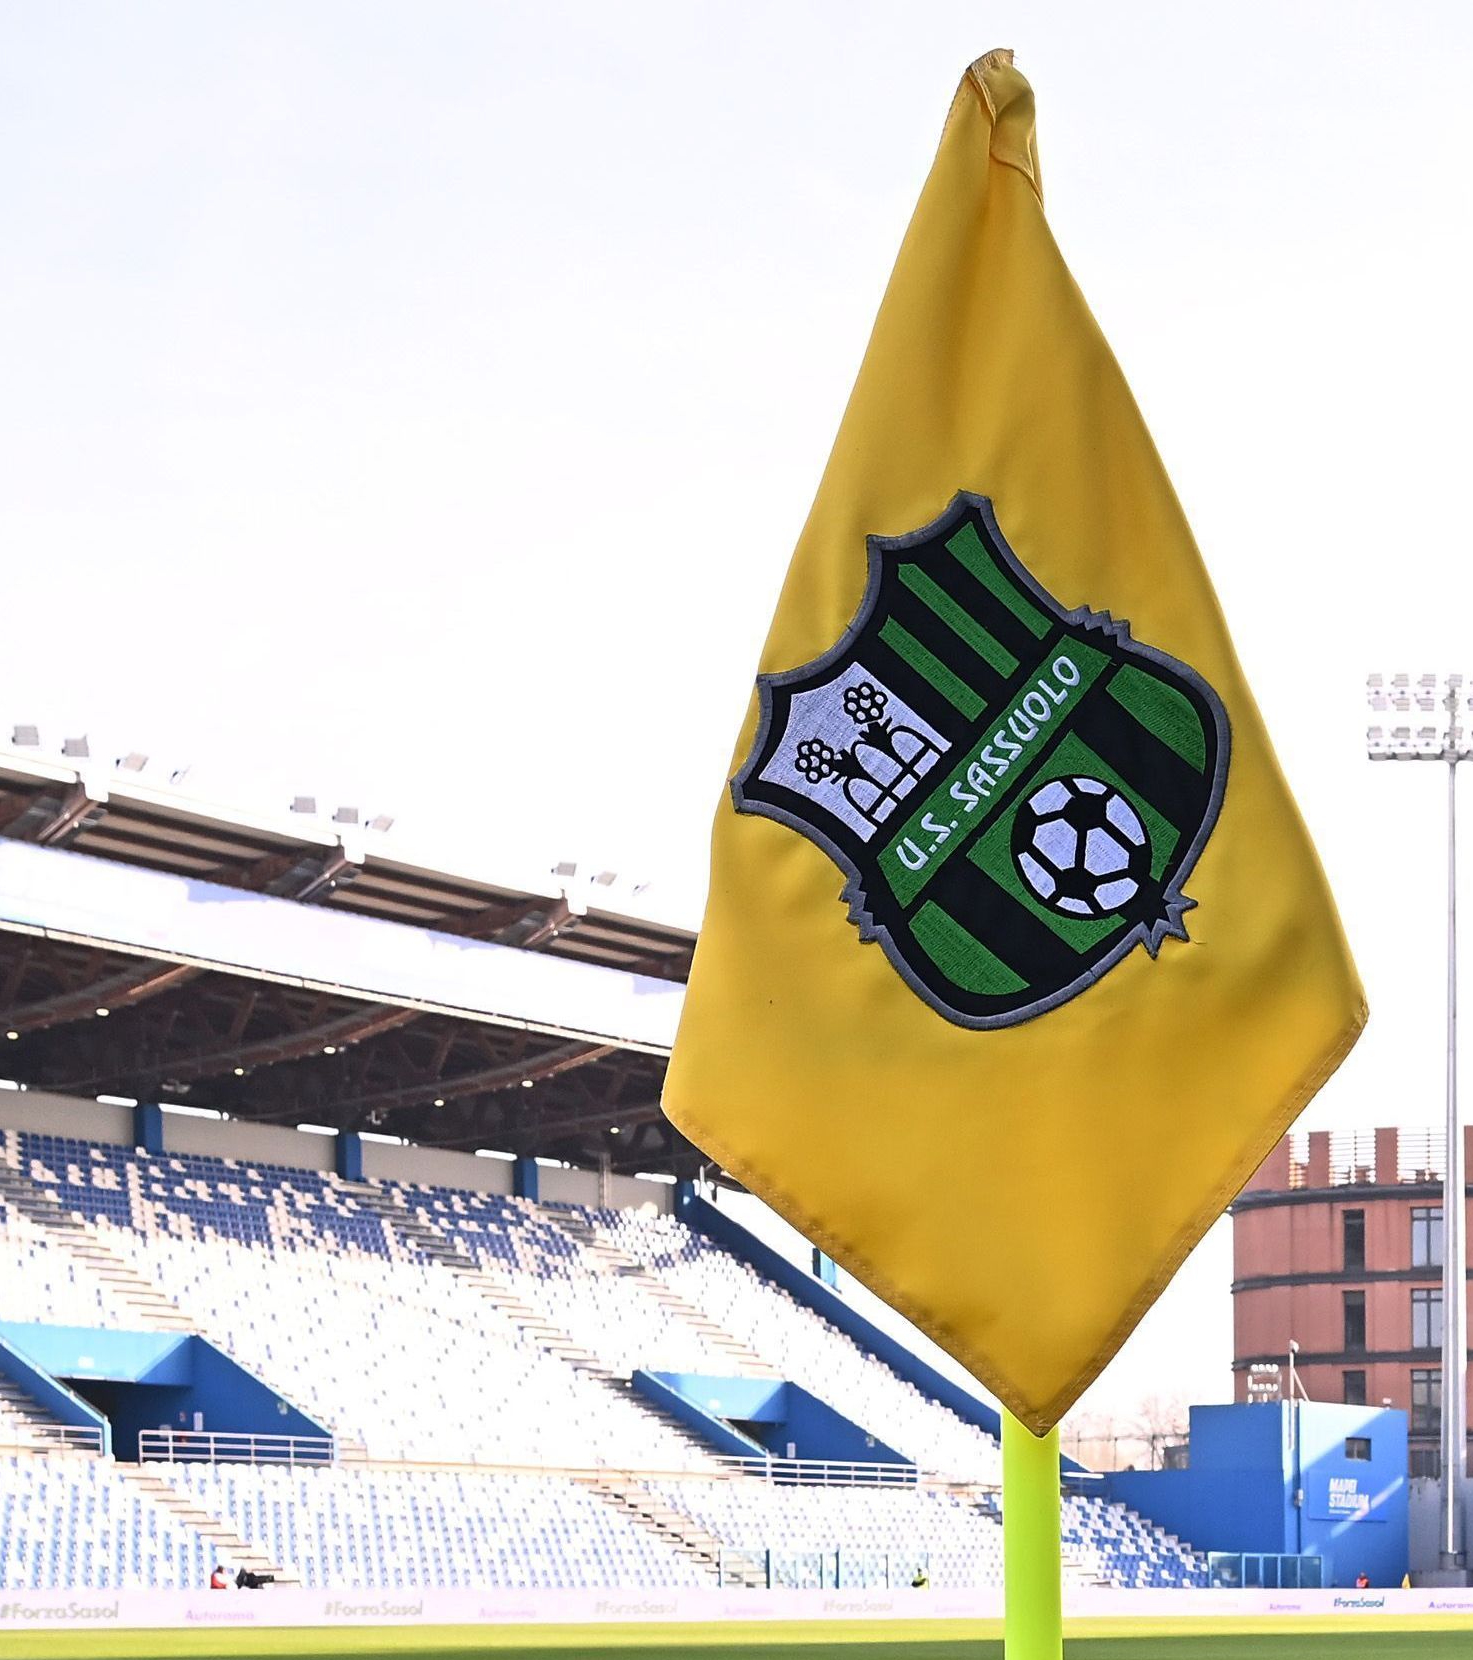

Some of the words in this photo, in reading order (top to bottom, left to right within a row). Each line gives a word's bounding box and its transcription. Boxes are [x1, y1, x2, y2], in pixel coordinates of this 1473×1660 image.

[896, 808, 959, 871] U.S.
[949, 655, 1082, 814] SASSUOLO
[0, 1600, 120, 1620] #ForzaSasol
[323, 1600, 424, 1617] #ForzaSasol
